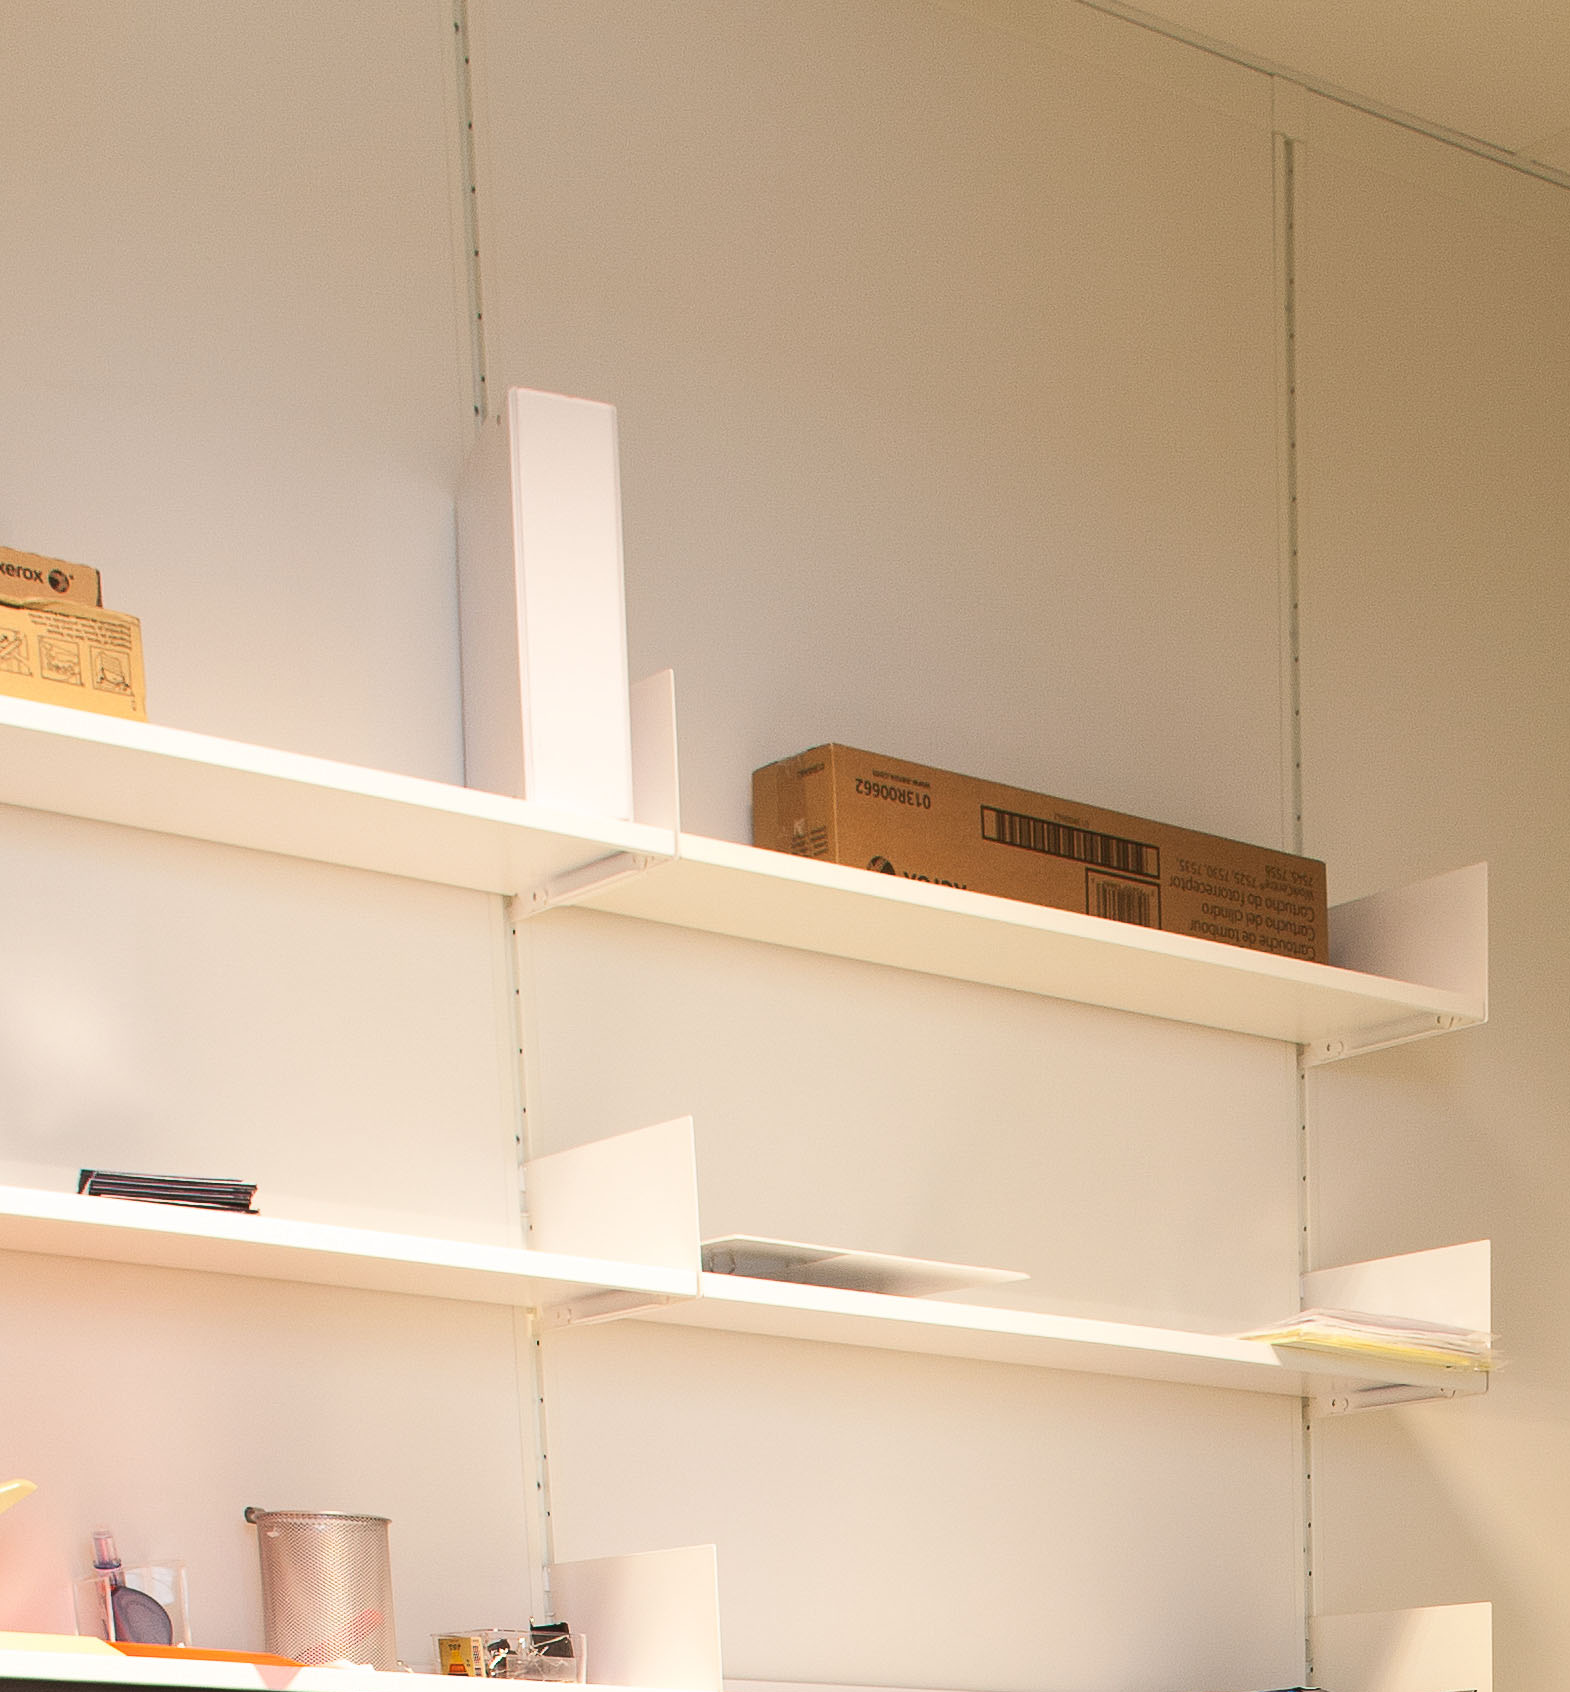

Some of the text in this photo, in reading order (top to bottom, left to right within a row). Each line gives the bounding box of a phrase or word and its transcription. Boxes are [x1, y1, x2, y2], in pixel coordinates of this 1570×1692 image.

[855, 777, 931, 810] 013R00662
[1245, 911, 1263, 928] del
[1265, 898, 1316, 923] Cartucho
[1240, 930, 1257, 946] de
[1264, 917, 1316, 942] Cartucho
[1258, 934, 1316, 960] Cartouche
